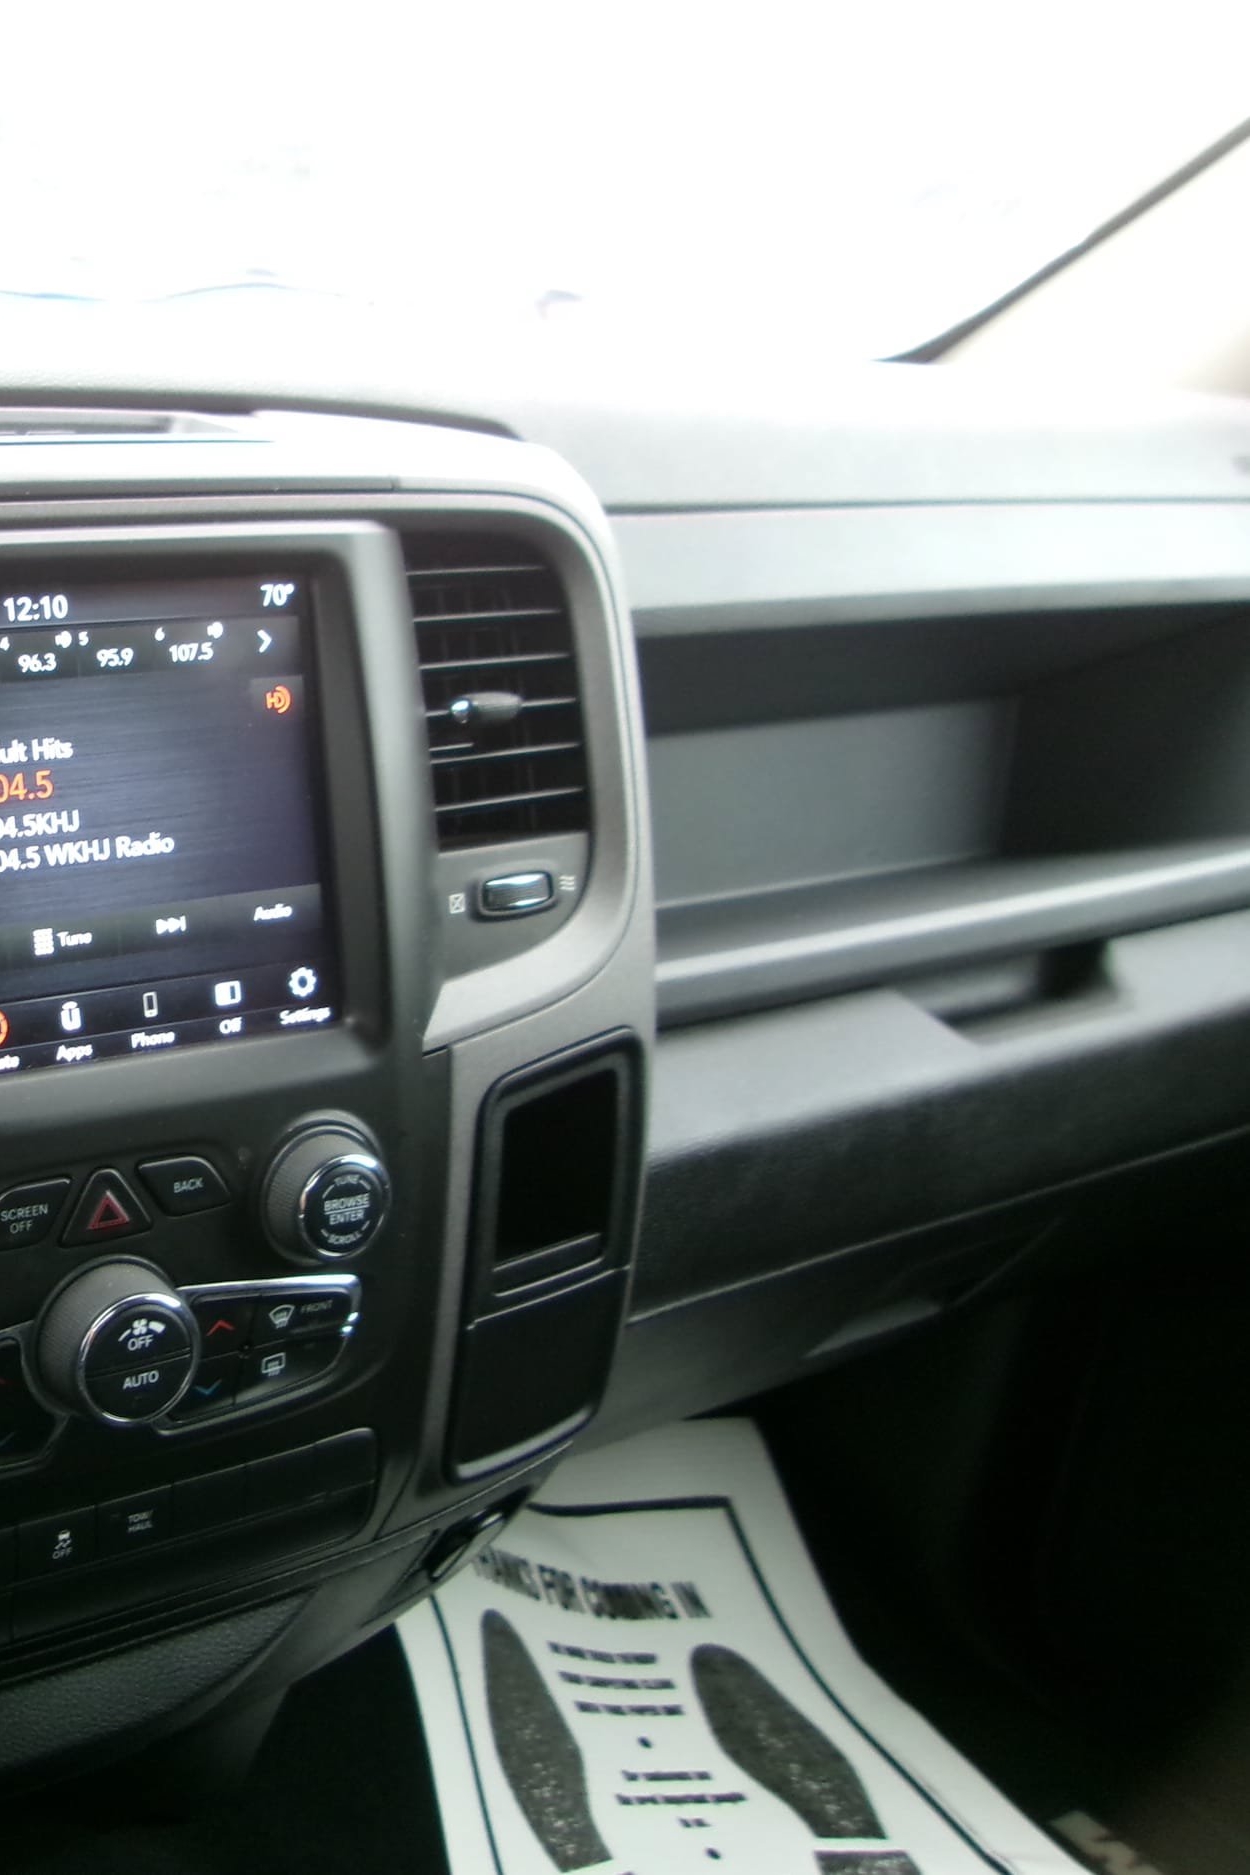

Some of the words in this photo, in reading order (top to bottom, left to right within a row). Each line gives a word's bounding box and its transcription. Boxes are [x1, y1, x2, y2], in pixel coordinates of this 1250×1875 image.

[3, 594, 68, 622] 12:10
[78, 631, 89, 646] 5
[155, 627, 166, 642] 6
[0, 637, 10, 651] 4
[169, 642, 215, 662] 107.5
[18, 653, 56, 673] 96.3
[96, 647, 134, 668] 95.9
[32, 737, 74, 761] Hits
[43, 838, 110, 866] WKHJ
[115, 832, 175, 859] Radio
[253, 903, 293, 921] Audio
[57, 930, 93, 948] Tune
[279, 1006, 331, 1025] Settings
[131, 1030, 175, 1048] Phone
[56, 1043, 93, 1062] Apps
[173, 1177, 203, 1193] BACK
[333, 1174, 361, 1187] TUNE
[324, 1193, 370, 1211] BROWSE
[0, 1203, 48, 1222] SCREEN
[329, 1209, 364, 1225] ENTER
[9, 1221, 33, 1234] OFF
[327, 1231, 361, 1245] SCROLL
[127, 1336, 154, 1351] OFF
[122, 1370, 160, 1390] AUTO
[52, 1547, 72, 1559] OFF
